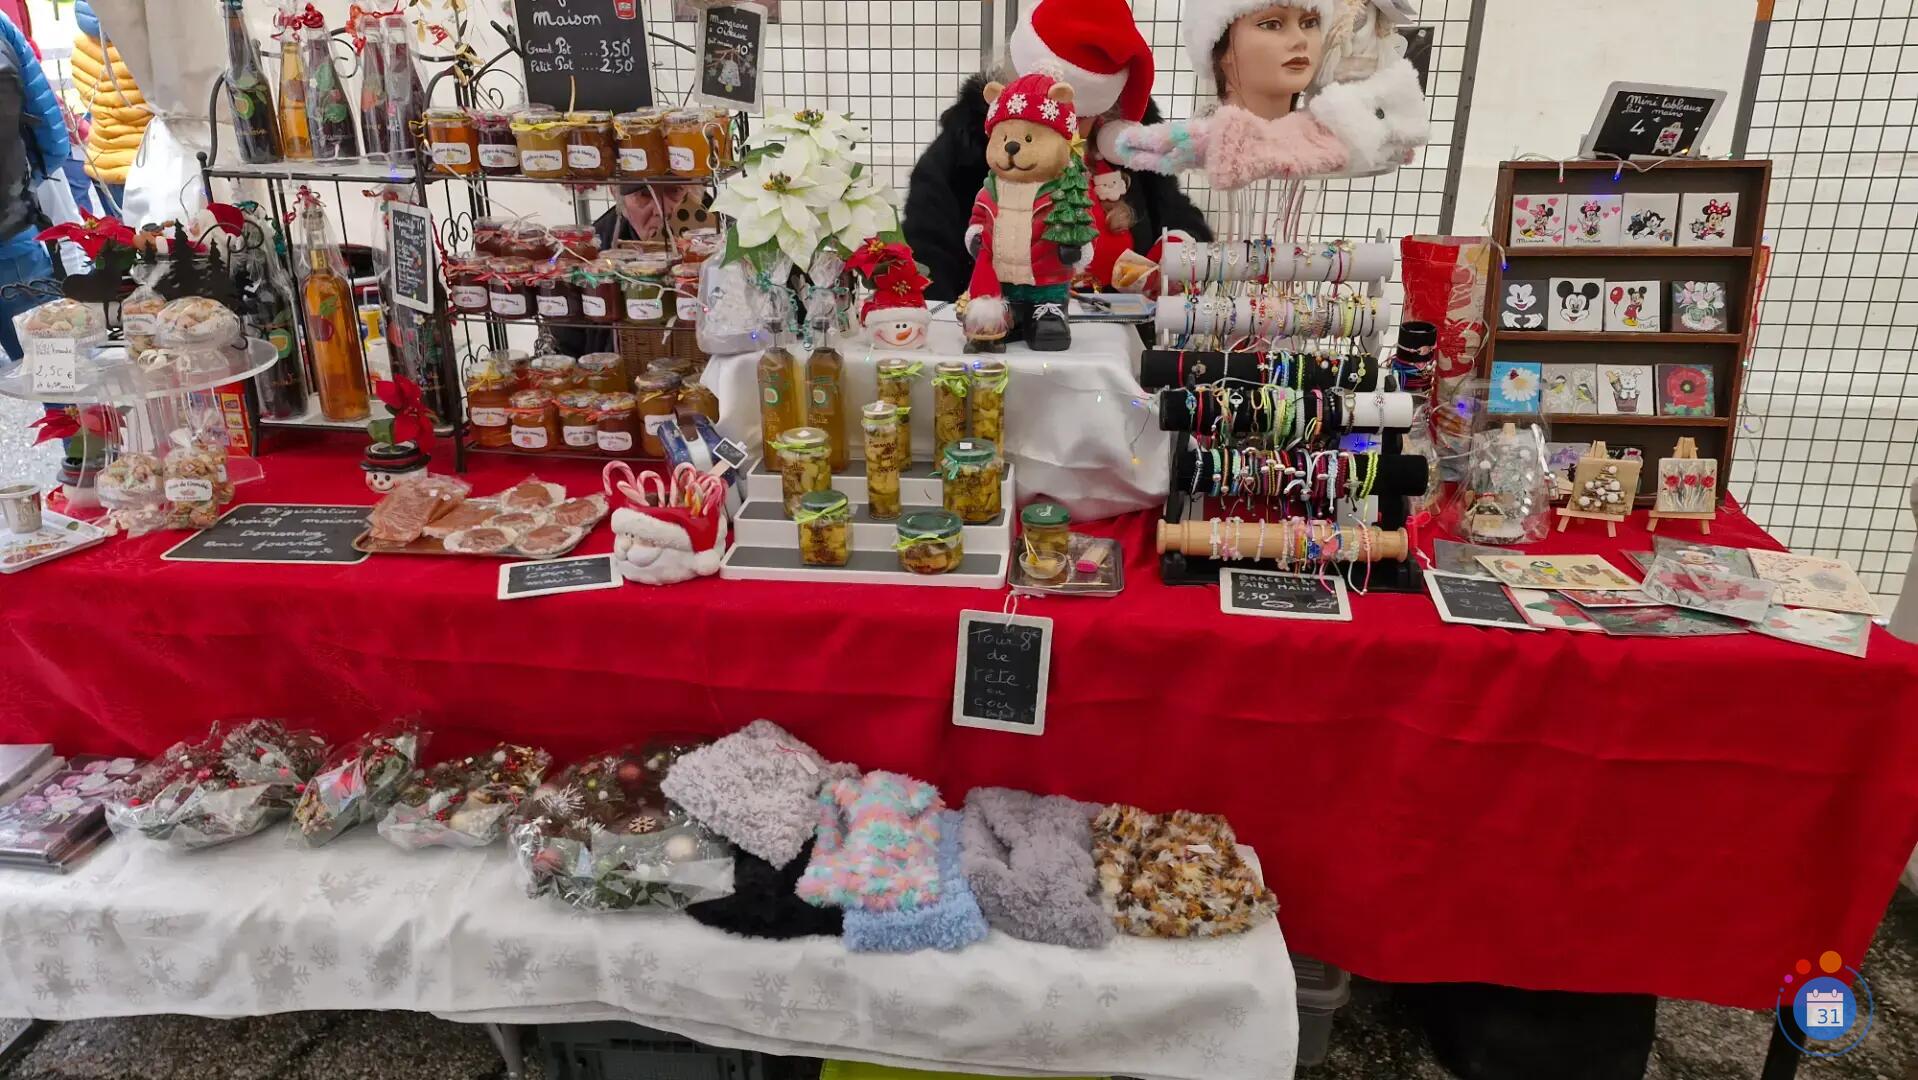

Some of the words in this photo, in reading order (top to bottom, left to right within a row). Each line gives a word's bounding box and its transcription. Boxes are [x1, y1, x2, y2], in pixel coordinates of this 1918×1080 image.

[533, 10, 601, 26] Maison
[525, 40, 553, 55] Grand
[555, 36, 572, 55] Pot
[555, 55, 574, 71] Pot
[1626, 94, 1659, 107] Mini
[1661, 96, 1704, 113] tableaux
[986, 648, 1011, 662] de
